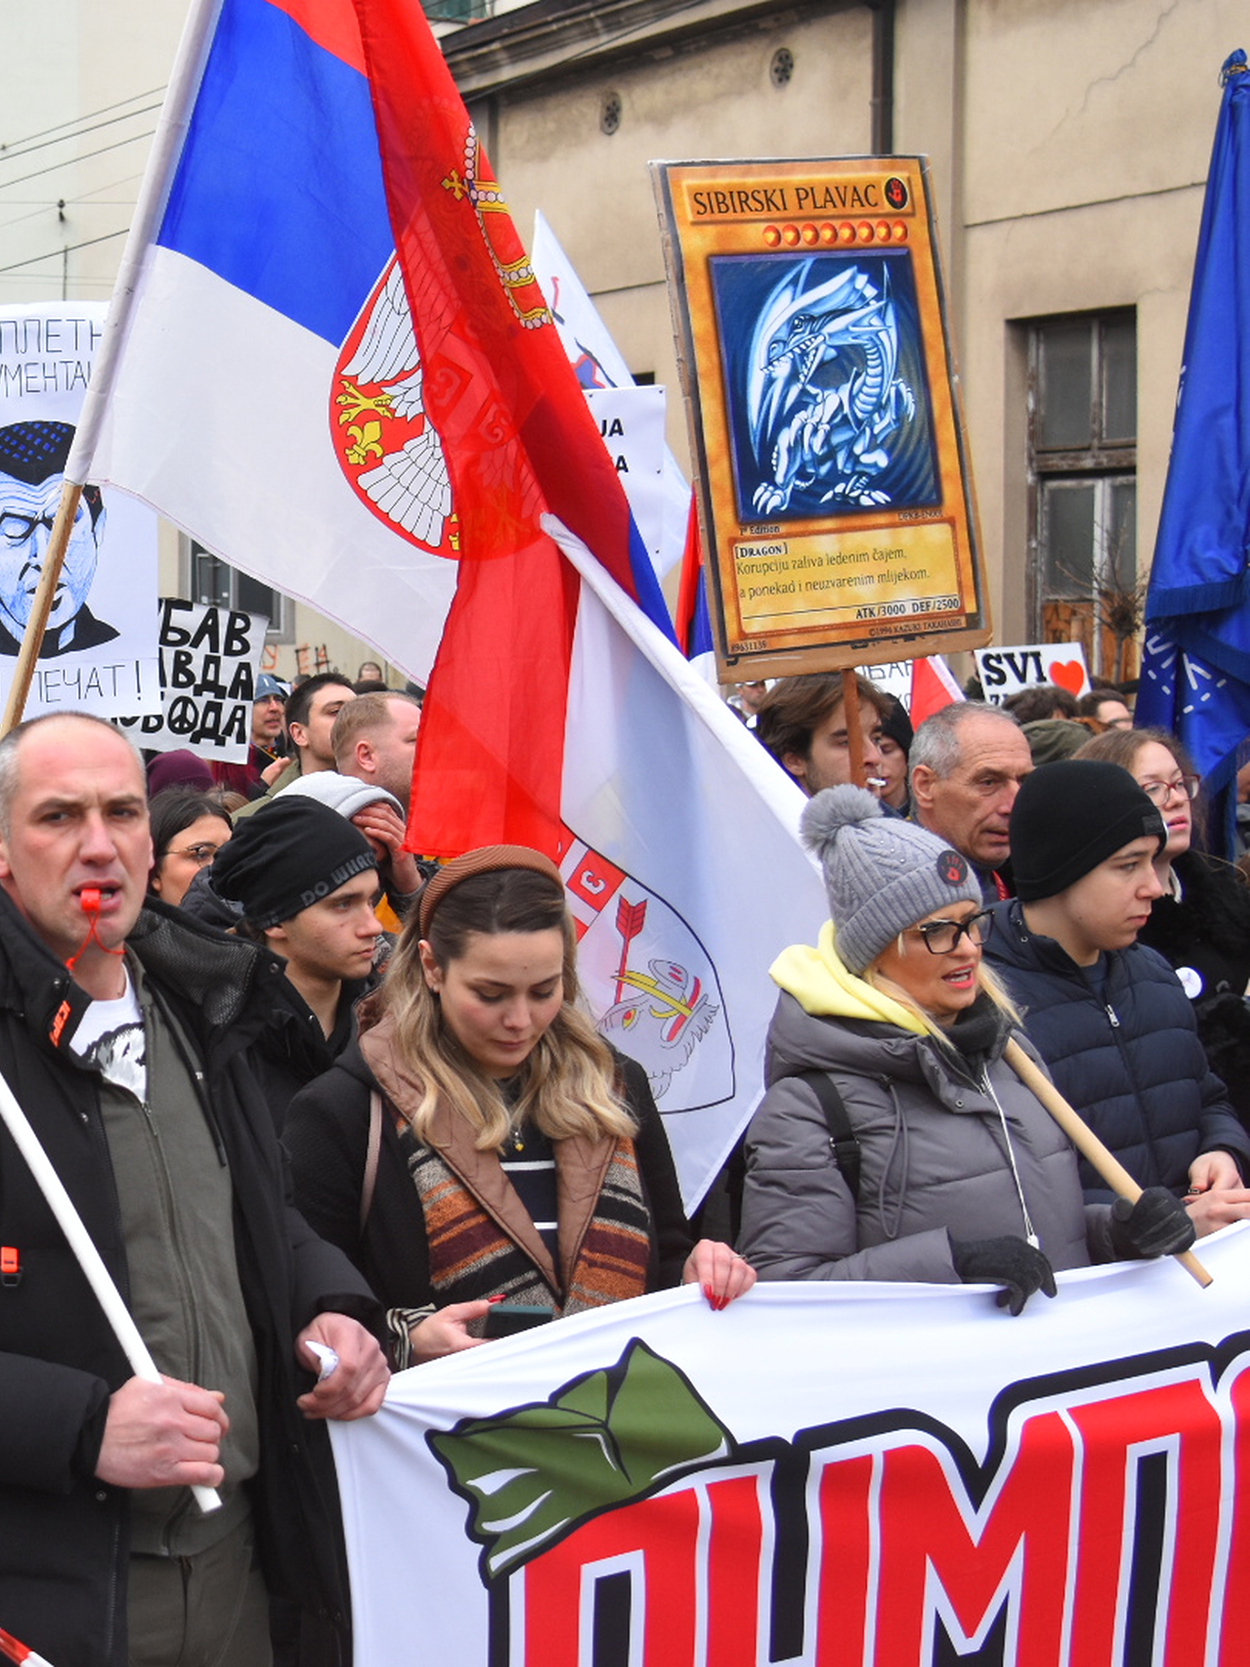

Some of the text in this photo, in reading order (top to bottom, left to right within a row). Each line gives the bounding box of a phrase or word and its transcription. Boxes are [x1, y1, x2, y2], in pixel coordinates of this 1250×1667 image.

[693, 184, 879, 215] SIBIRSKI PLAVAC
[749, 524, 780, 535] Edition
[736, 560, 789, 577] Korupciju
[792, 556, 824, 570] zaliva
[826, 552, 870, 566] ledenim
[739, 589, 746, 598] a
[749, 580, 796, 600] ponekad
[806, 574, 875, 593] neuzvarenim
[877, 568, 930, 586] mlijekom.
[855, 598, 960, 620] ATK/3000 DEF/2500
[158, 598, 251, 657] БАВ
[981, 651, 1047, 686] SVI
